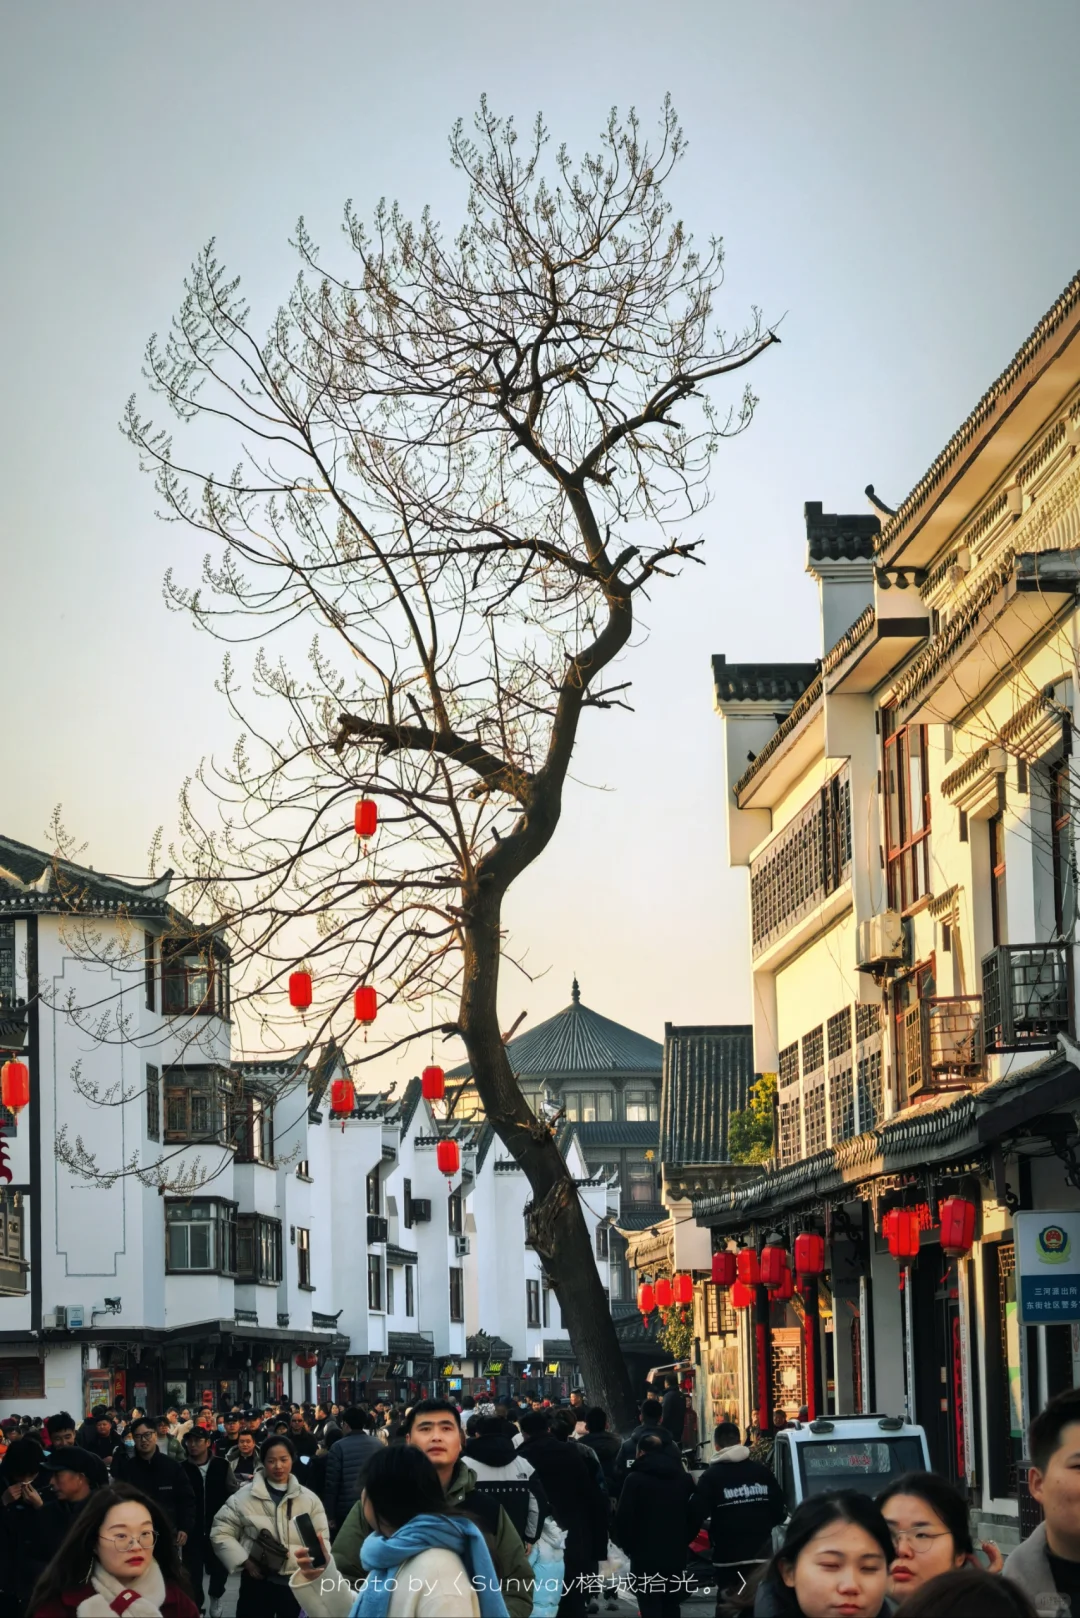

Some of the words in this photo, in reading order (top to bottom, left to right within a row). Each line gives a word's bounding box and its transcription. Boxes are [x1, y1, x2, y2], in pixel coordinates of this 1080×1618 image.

[1026, 1300, 1080, 1309] 东街社区警务
